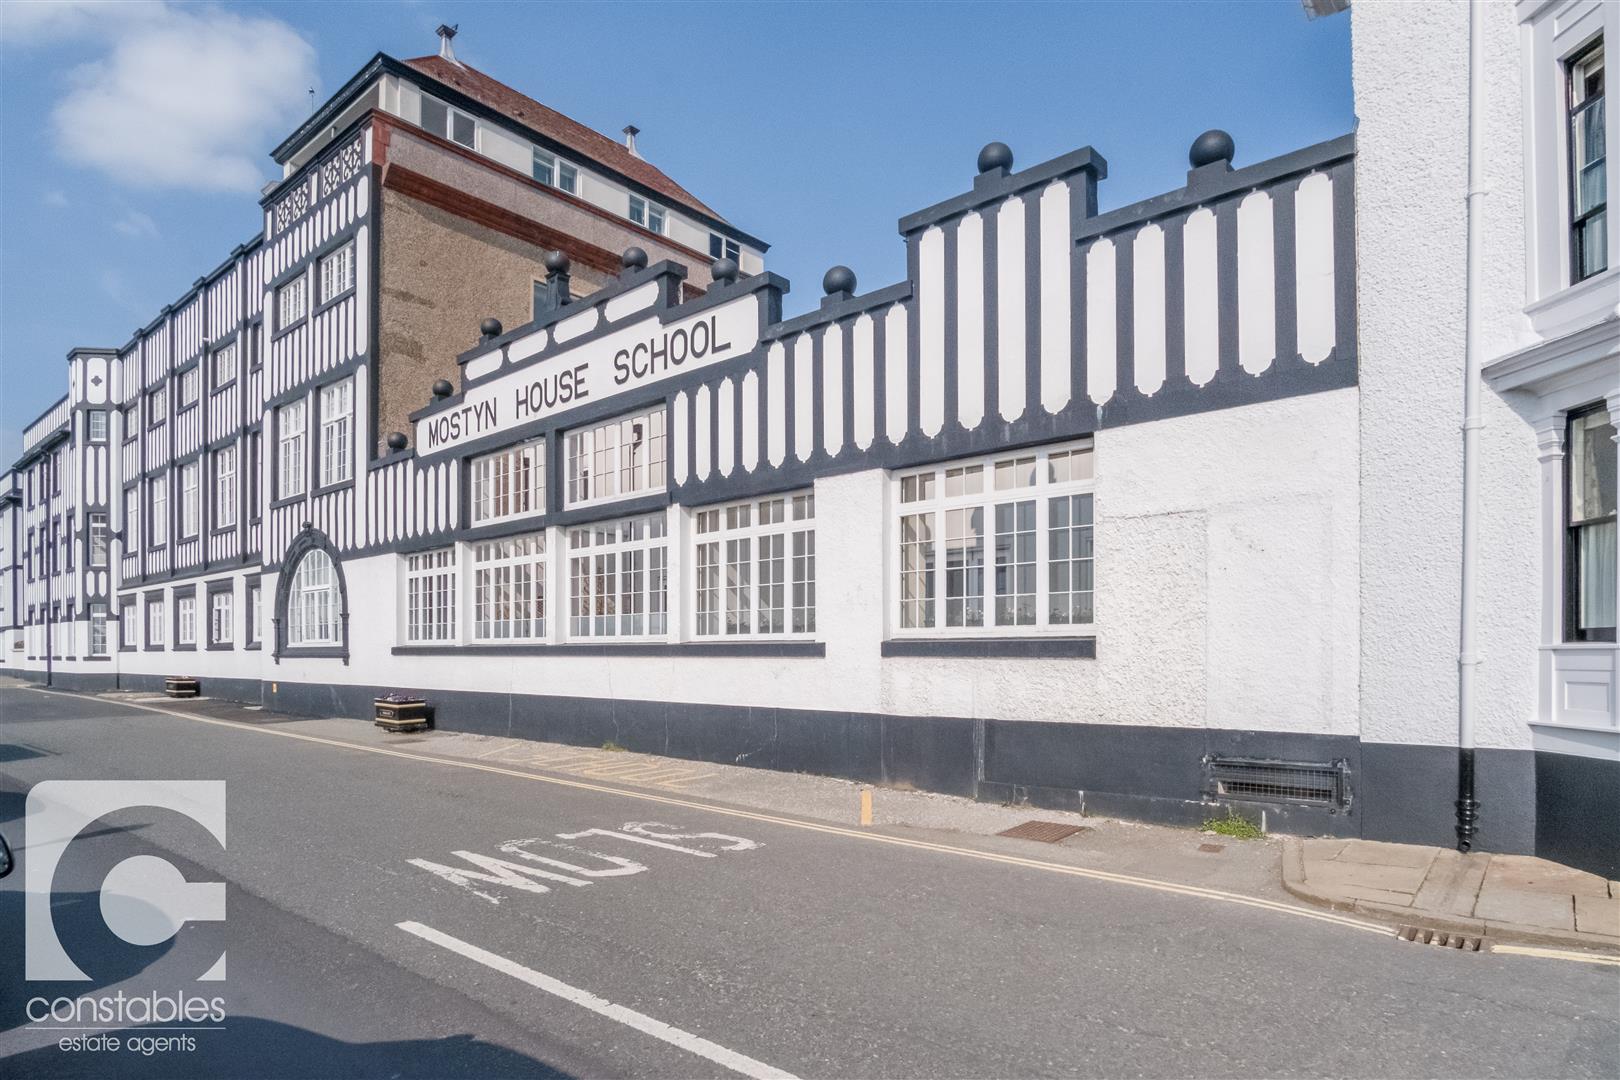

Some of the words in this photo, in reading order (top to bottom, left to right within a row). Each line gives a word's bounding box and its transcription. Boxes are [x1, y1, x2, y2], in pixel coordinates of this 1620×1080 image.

[428, 397, 498, 449] MOSTYN
[515, 362, 590, 420] HOUSE
[613, 315, 732, 386] SCHOOL
[405, 821, 767, 905] SLOW
